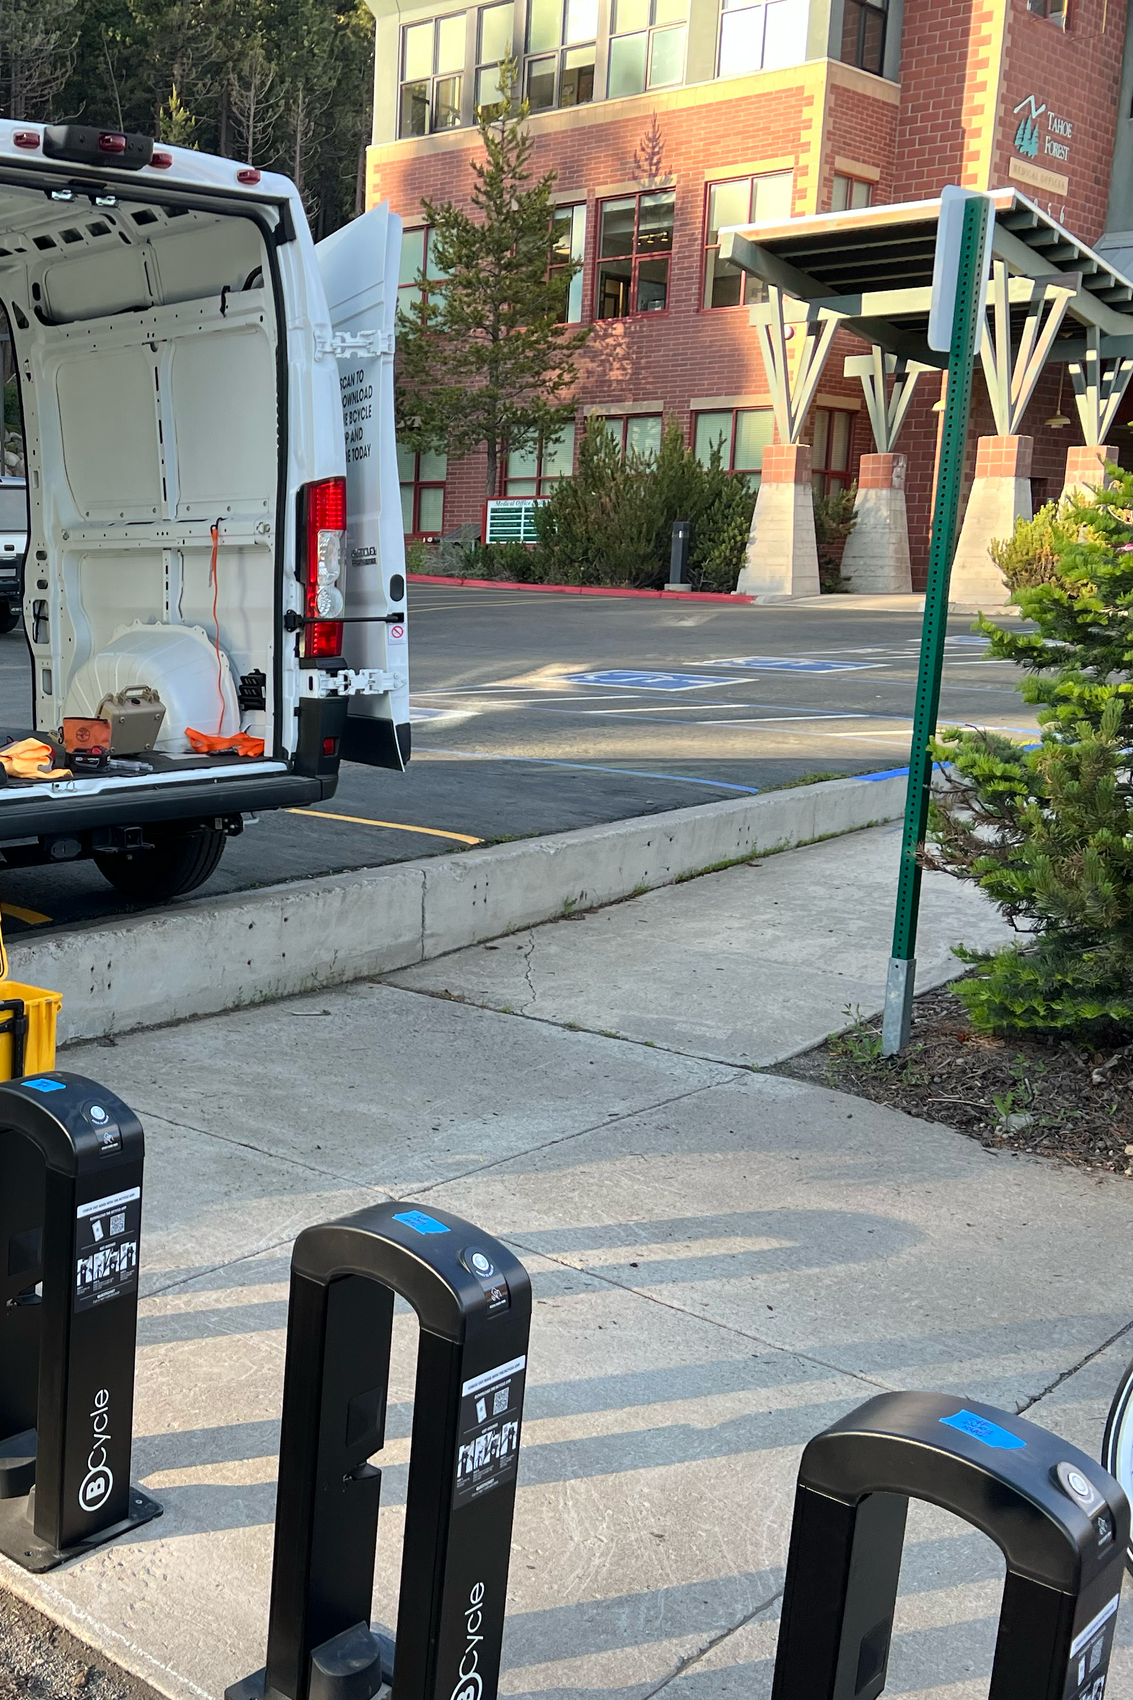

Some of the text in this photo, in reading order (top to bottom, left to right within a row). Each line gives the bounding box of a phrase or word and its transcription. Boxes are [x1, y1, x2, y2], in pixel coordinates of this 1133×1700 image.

[1047, 111, 1073, 138] TAHOE
[1044, 135, 1070, 161] FOREST
[1013, 164, 1065, 190] MEDICAL OFFICES
[356, 369, 364, 385] TO
[342, 385, 373, 409] OWNLOAD
[349, 405, 372, 426] BCYCLE
[350, 427, 364, 444] AND
[352, 443, 372, 462] TODAY
[79, 1388, 114, 1512] BCycle
